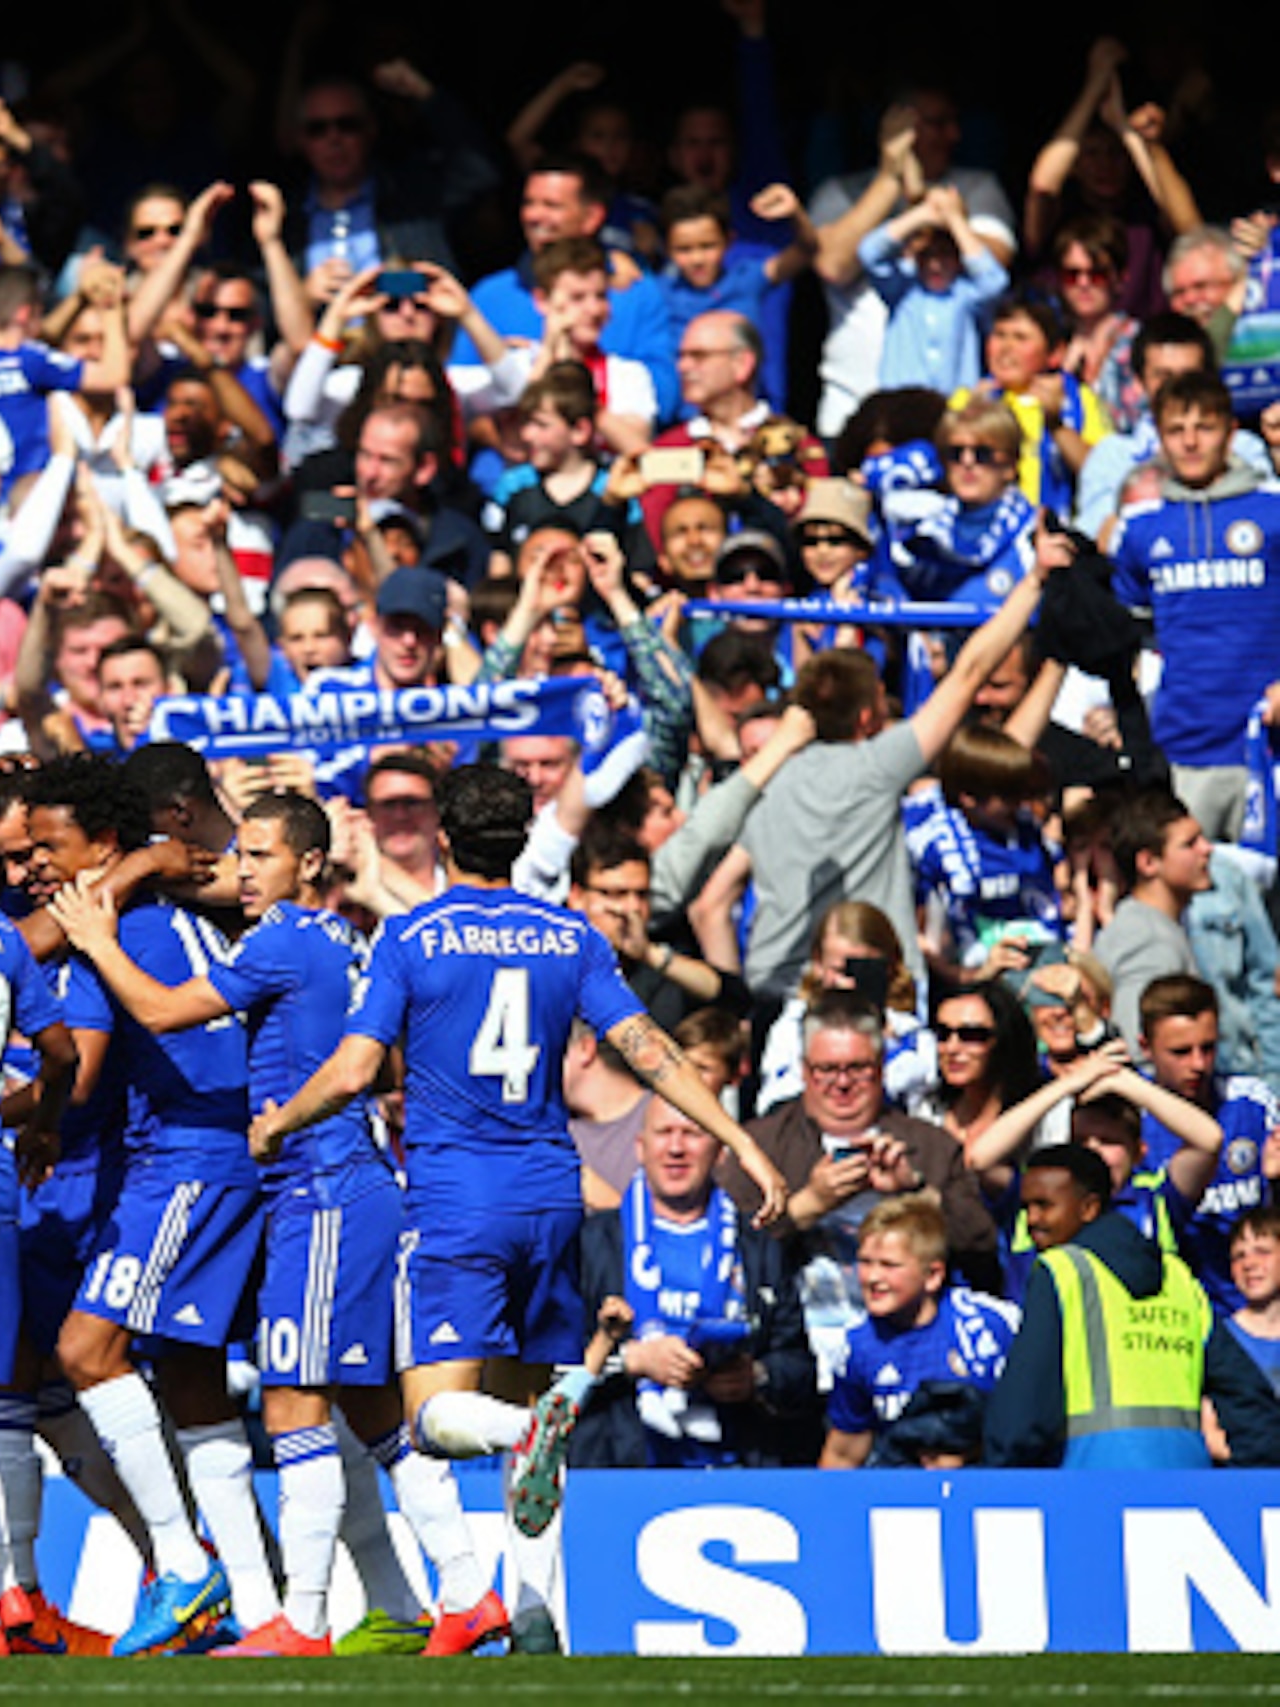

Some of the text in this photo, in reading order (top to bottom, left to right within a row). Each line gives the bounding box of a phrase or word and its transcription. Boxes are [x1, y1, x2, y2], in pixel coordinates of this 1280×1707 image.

[1148, 558, 1266, 593] SAMSUNG
[148, 680, 542, 751] CHAMPIONS
[469, 967, 540, 1103] 4
[84, 1249, 142, 1309] 18
[259, 1316, 300, 1373] 10
